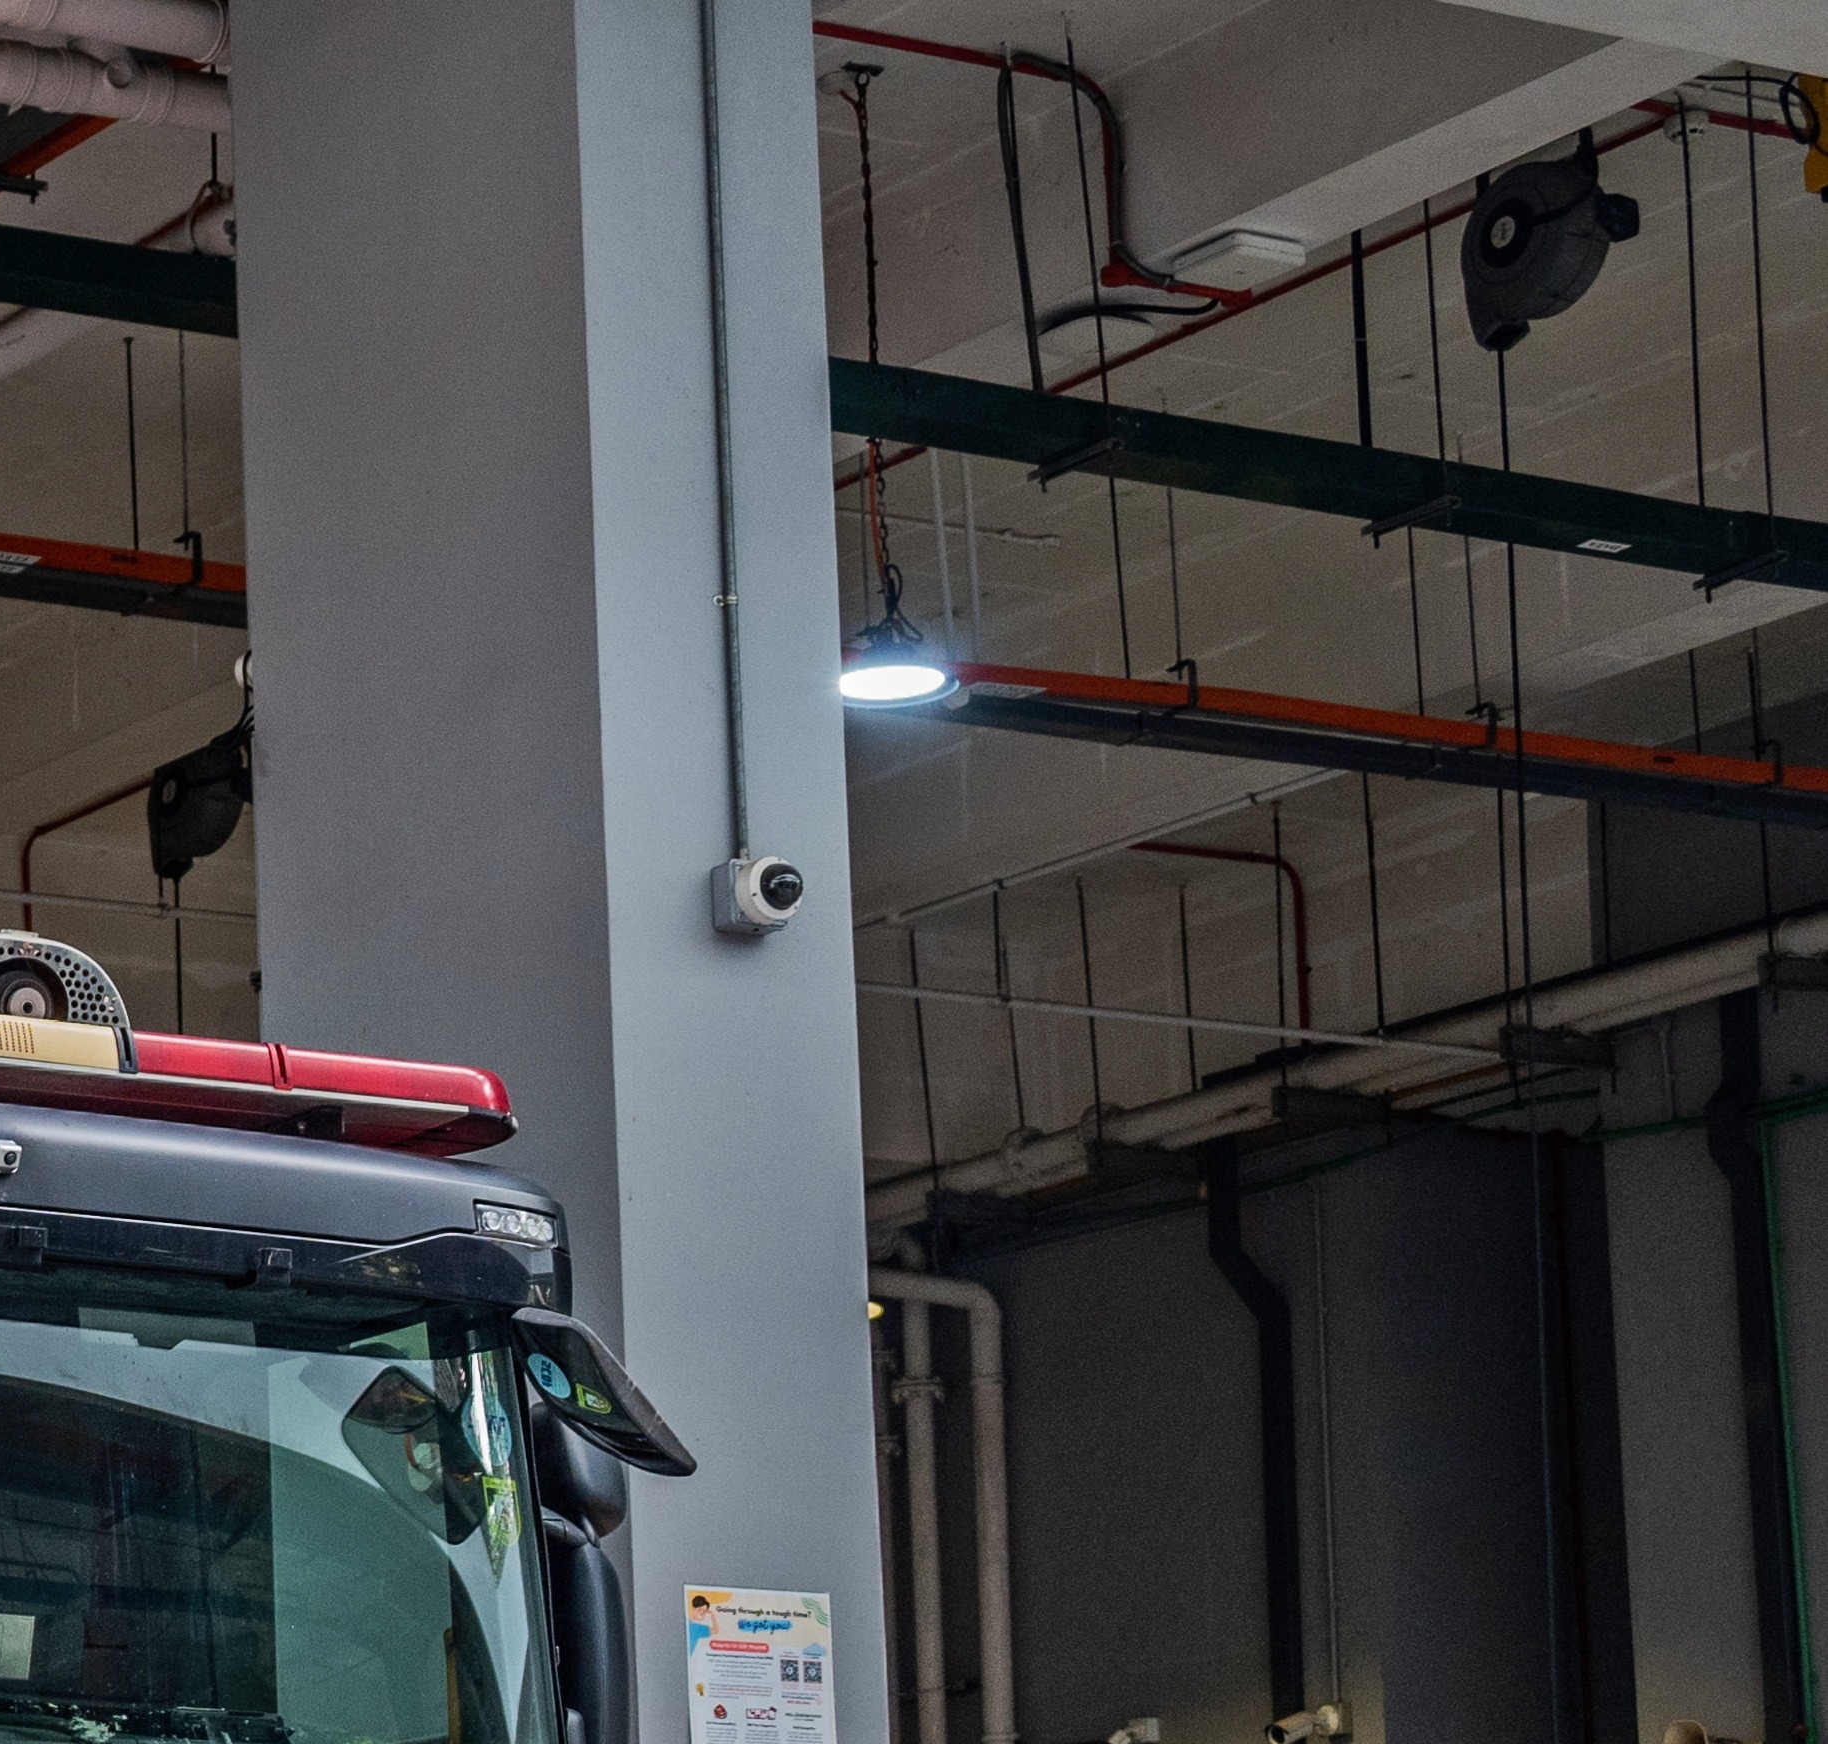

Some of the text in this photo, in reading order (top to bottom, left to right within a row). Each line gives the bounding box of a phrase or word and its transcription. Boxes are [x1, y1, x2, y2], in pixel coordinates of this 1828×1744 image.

[716, 1605, 736, 1615] Going
[738, 1606, 764, 1617] through
[772, 1609, 791, 1618] tough
[793, 1608, 812, 1618] time?
[738, 1619, 751, 1630] We
[752, 1618, 768, 1634] got
